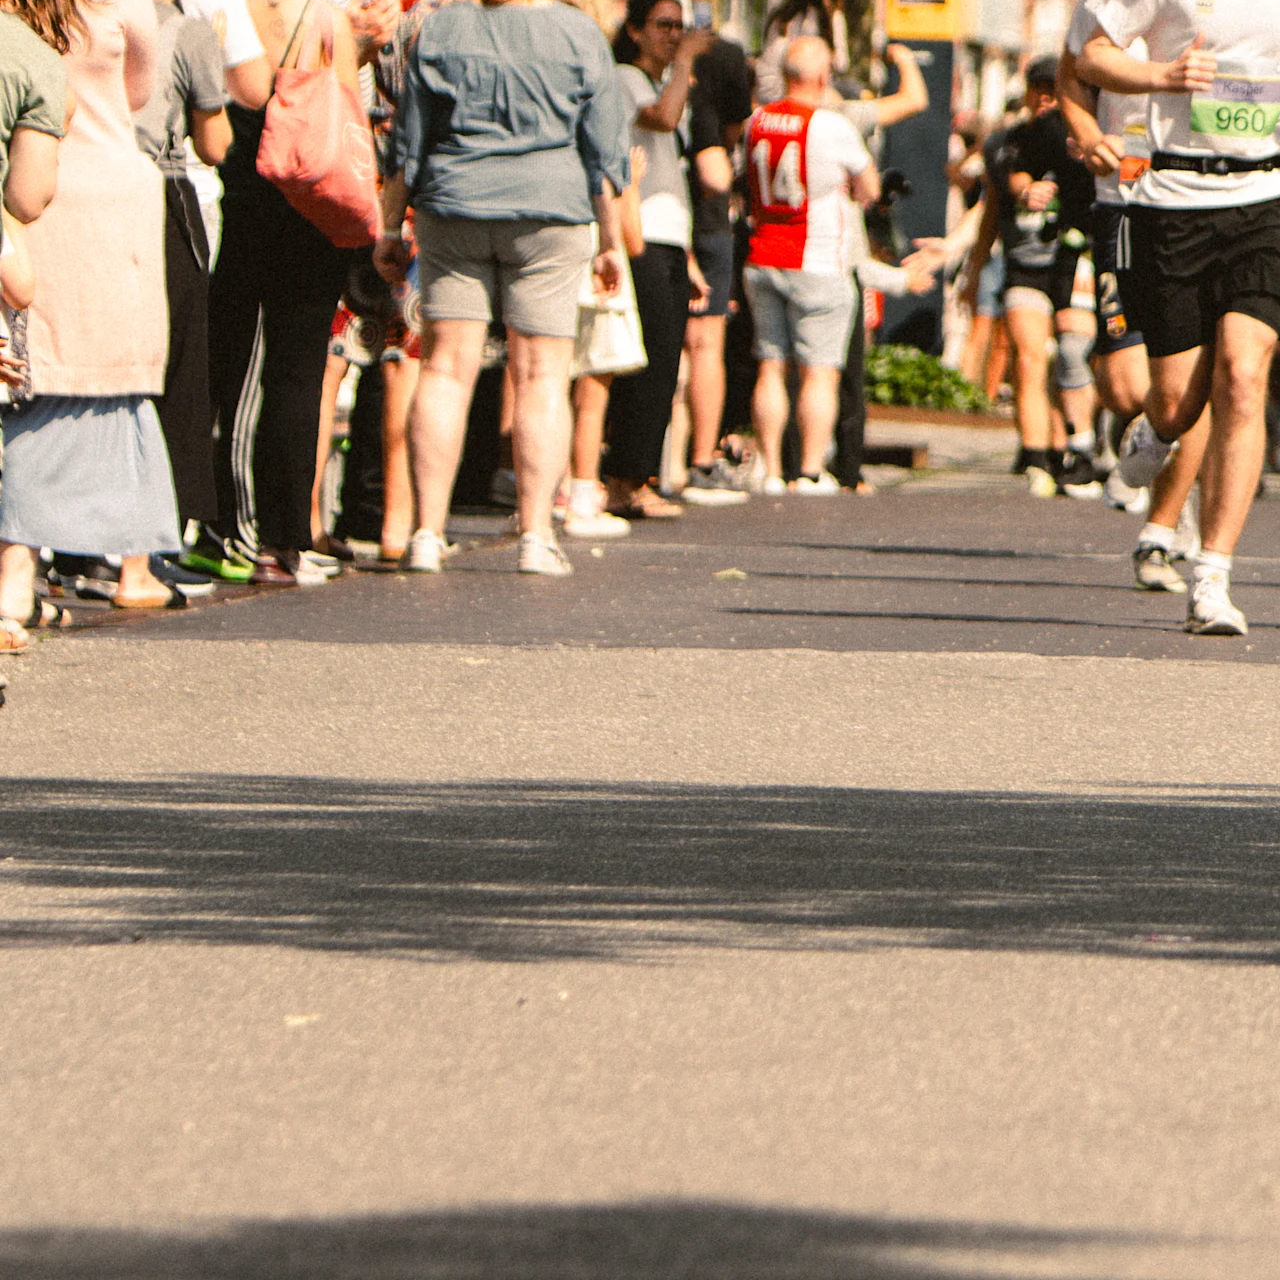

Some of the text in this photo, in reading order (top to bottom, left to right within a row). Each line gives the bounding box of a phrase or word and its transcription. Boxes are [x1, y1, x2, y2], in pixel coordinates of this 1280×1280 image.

[1222, 80, 1265, 97] Kasper
[1214, 106, 1266, 133] 960
[753, 139, 805, 210] 14
